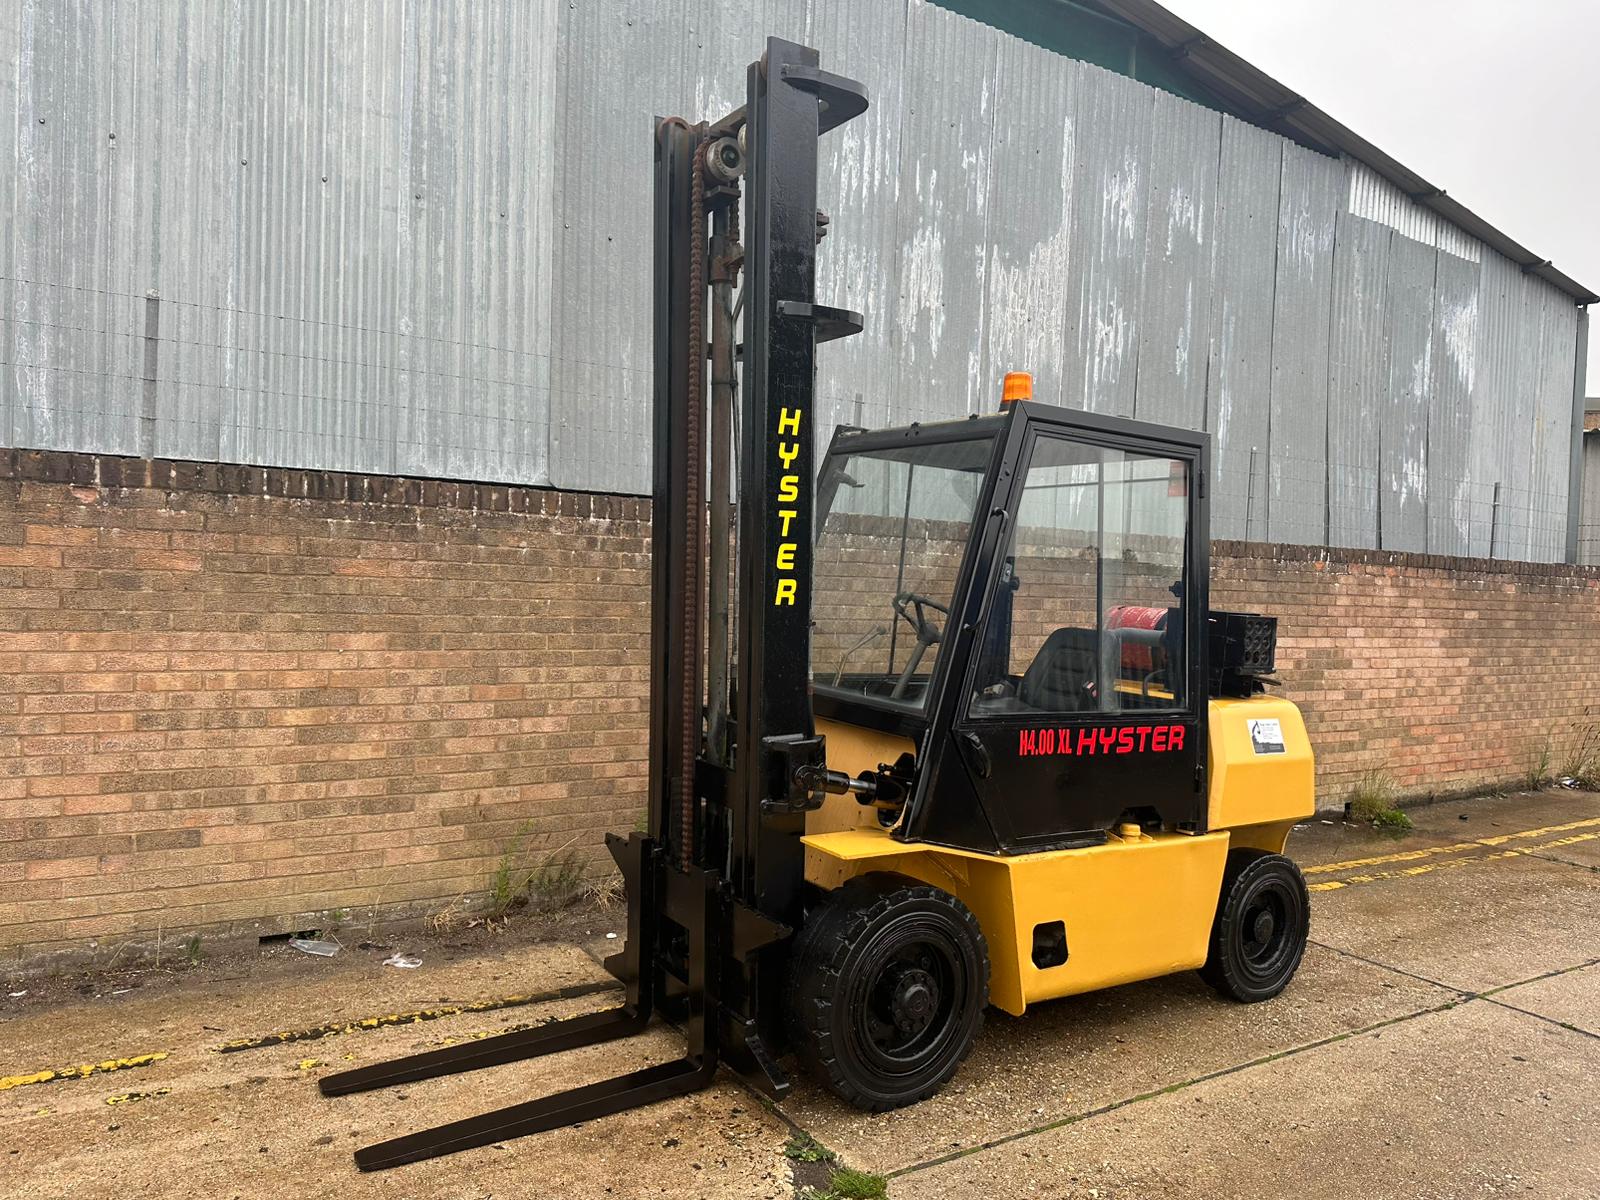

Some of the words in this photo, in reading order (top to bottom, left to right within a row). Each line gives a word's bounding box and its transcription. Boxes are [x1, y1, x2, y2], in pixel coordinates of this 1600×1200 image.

[776, 408, 800, 605] HYSTER
[1020, 729, 1054, 755] H4.00
[1058, 729, 1072, 754] XL
[1077, 725, 1185, 755] HYSTER
